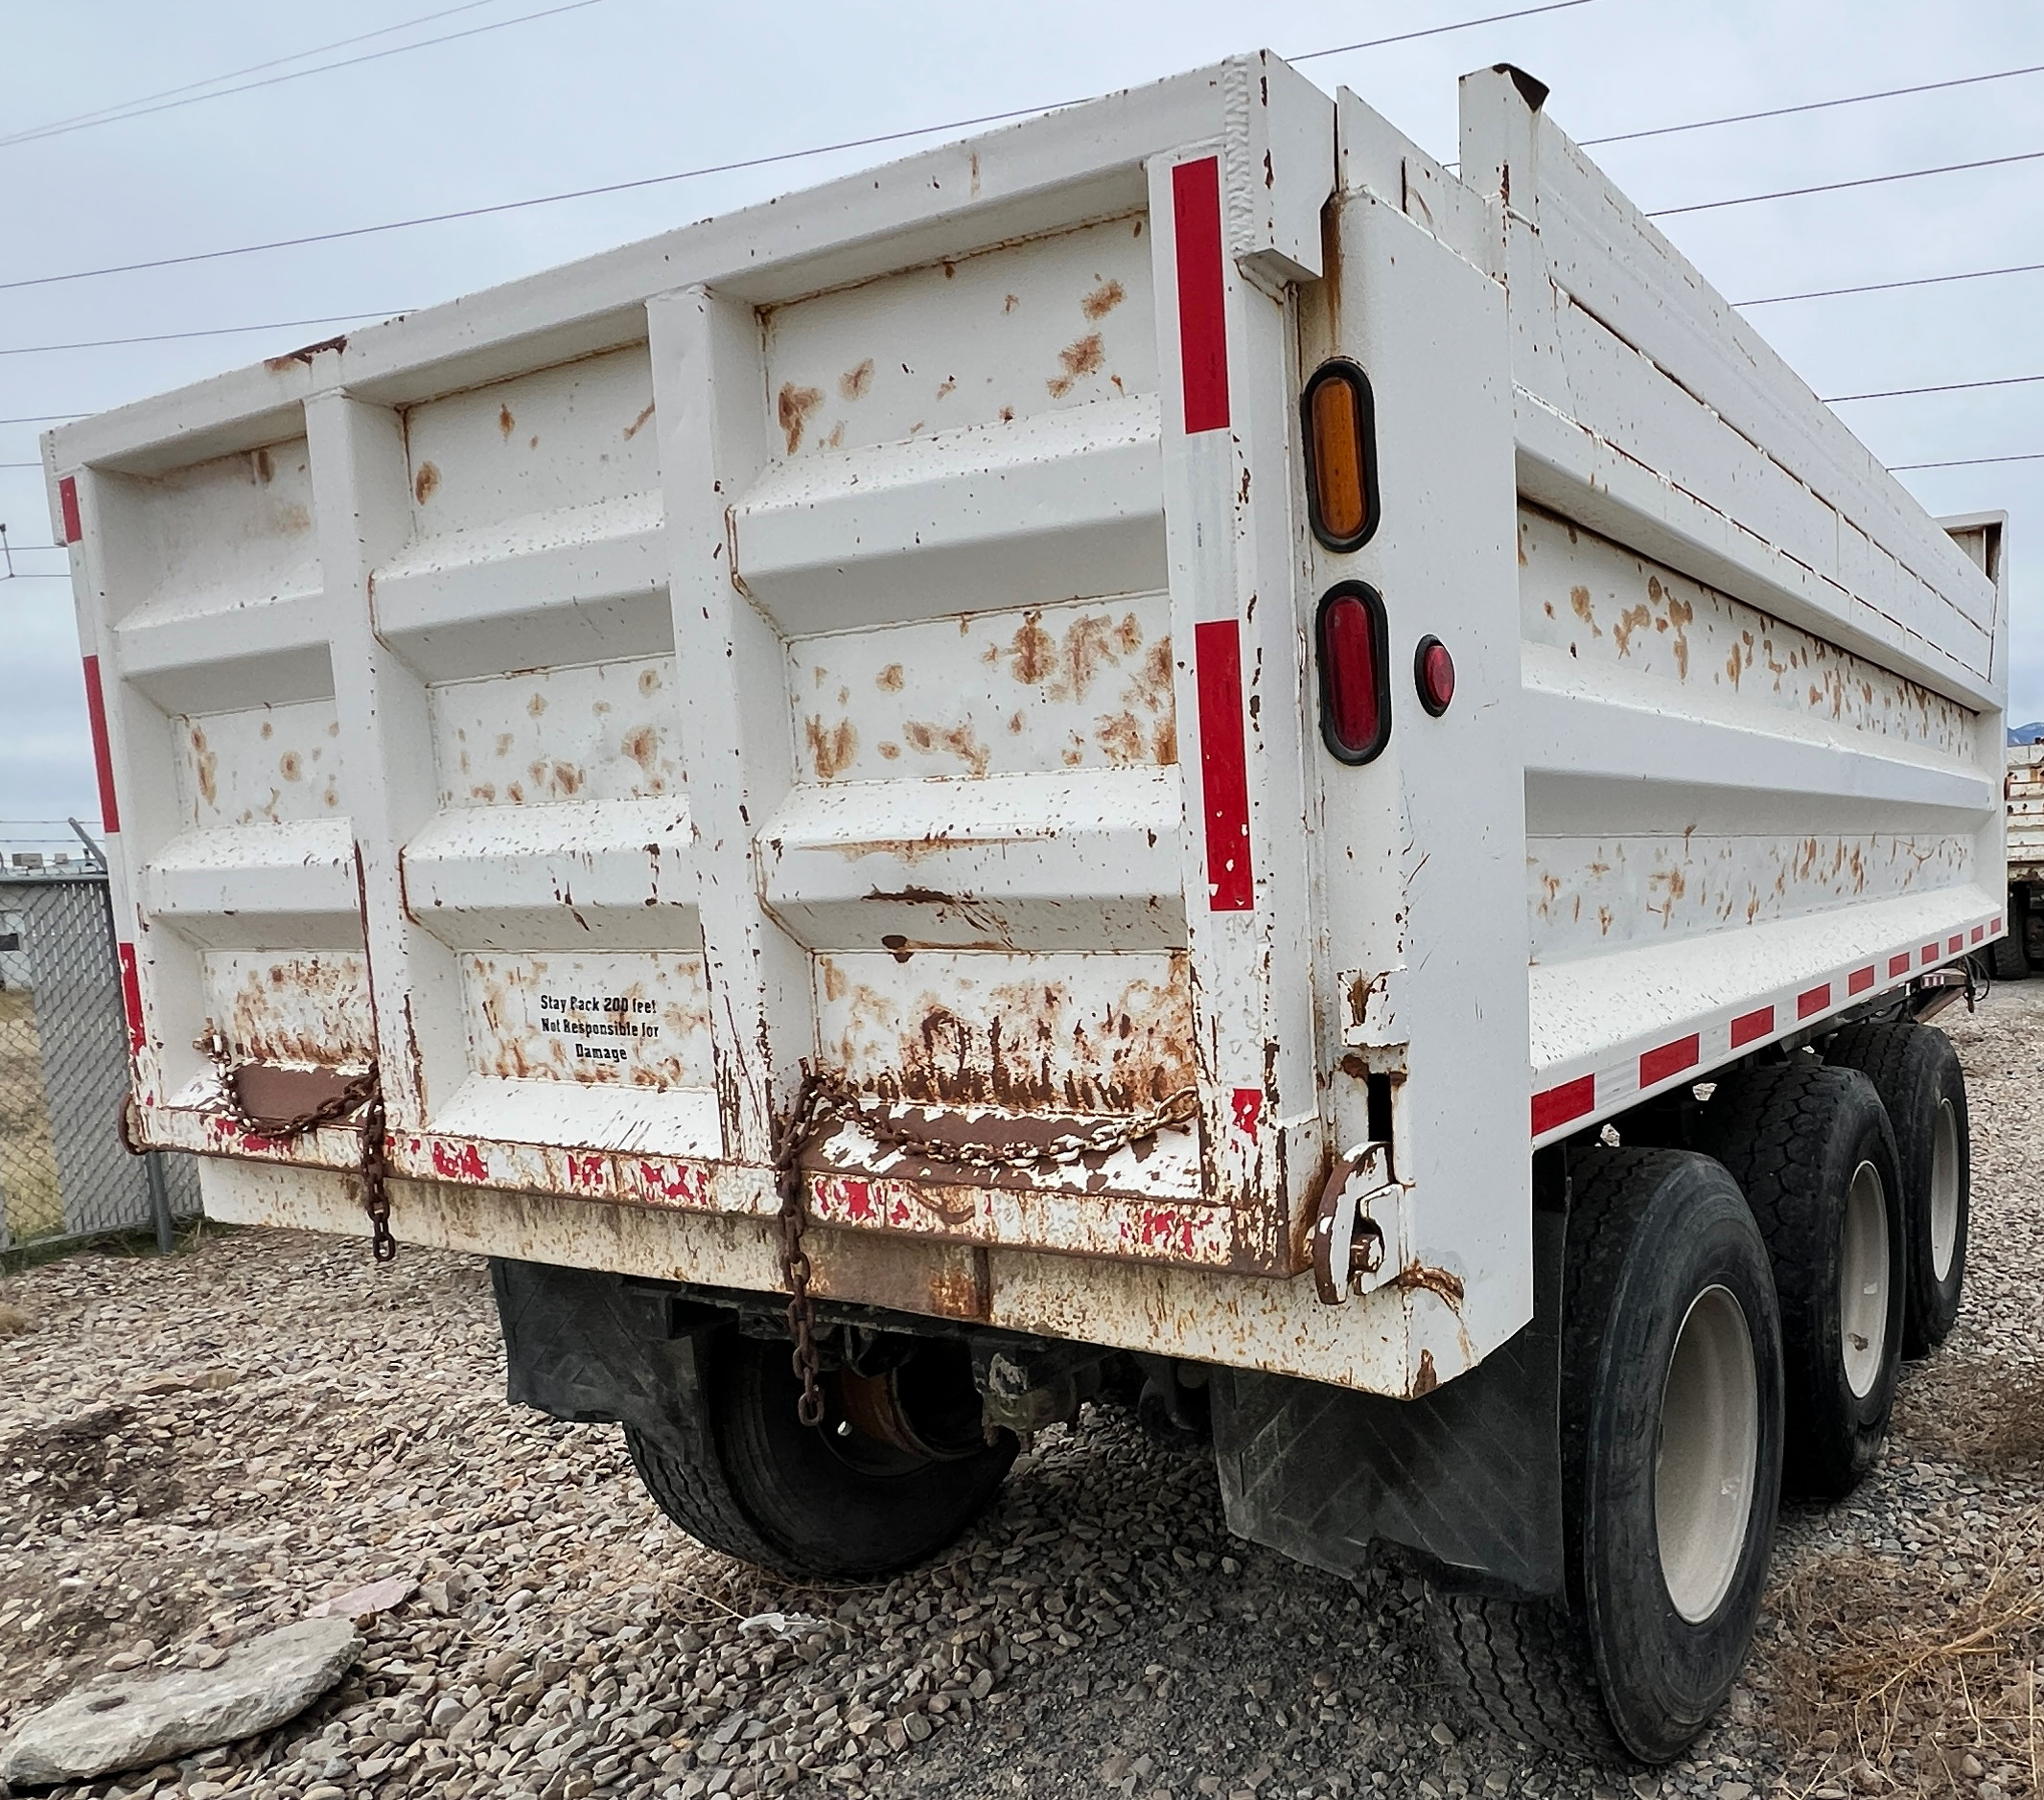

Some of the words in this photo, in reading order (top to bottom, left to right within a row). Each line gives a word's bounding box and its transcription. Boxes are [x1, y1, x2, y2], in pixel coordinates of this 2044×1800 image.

[541, 995, 567, 1013] Stay
[604, 997, 629, 1012] 200
[633, 998, 657, 1014] feet
[541, 1018, 561, 1033] Not
[564, 1018, 639, 1038] Responsible
[642, 1022, 660, 1038] for
[575, 1043, 628, 1063] Damage
